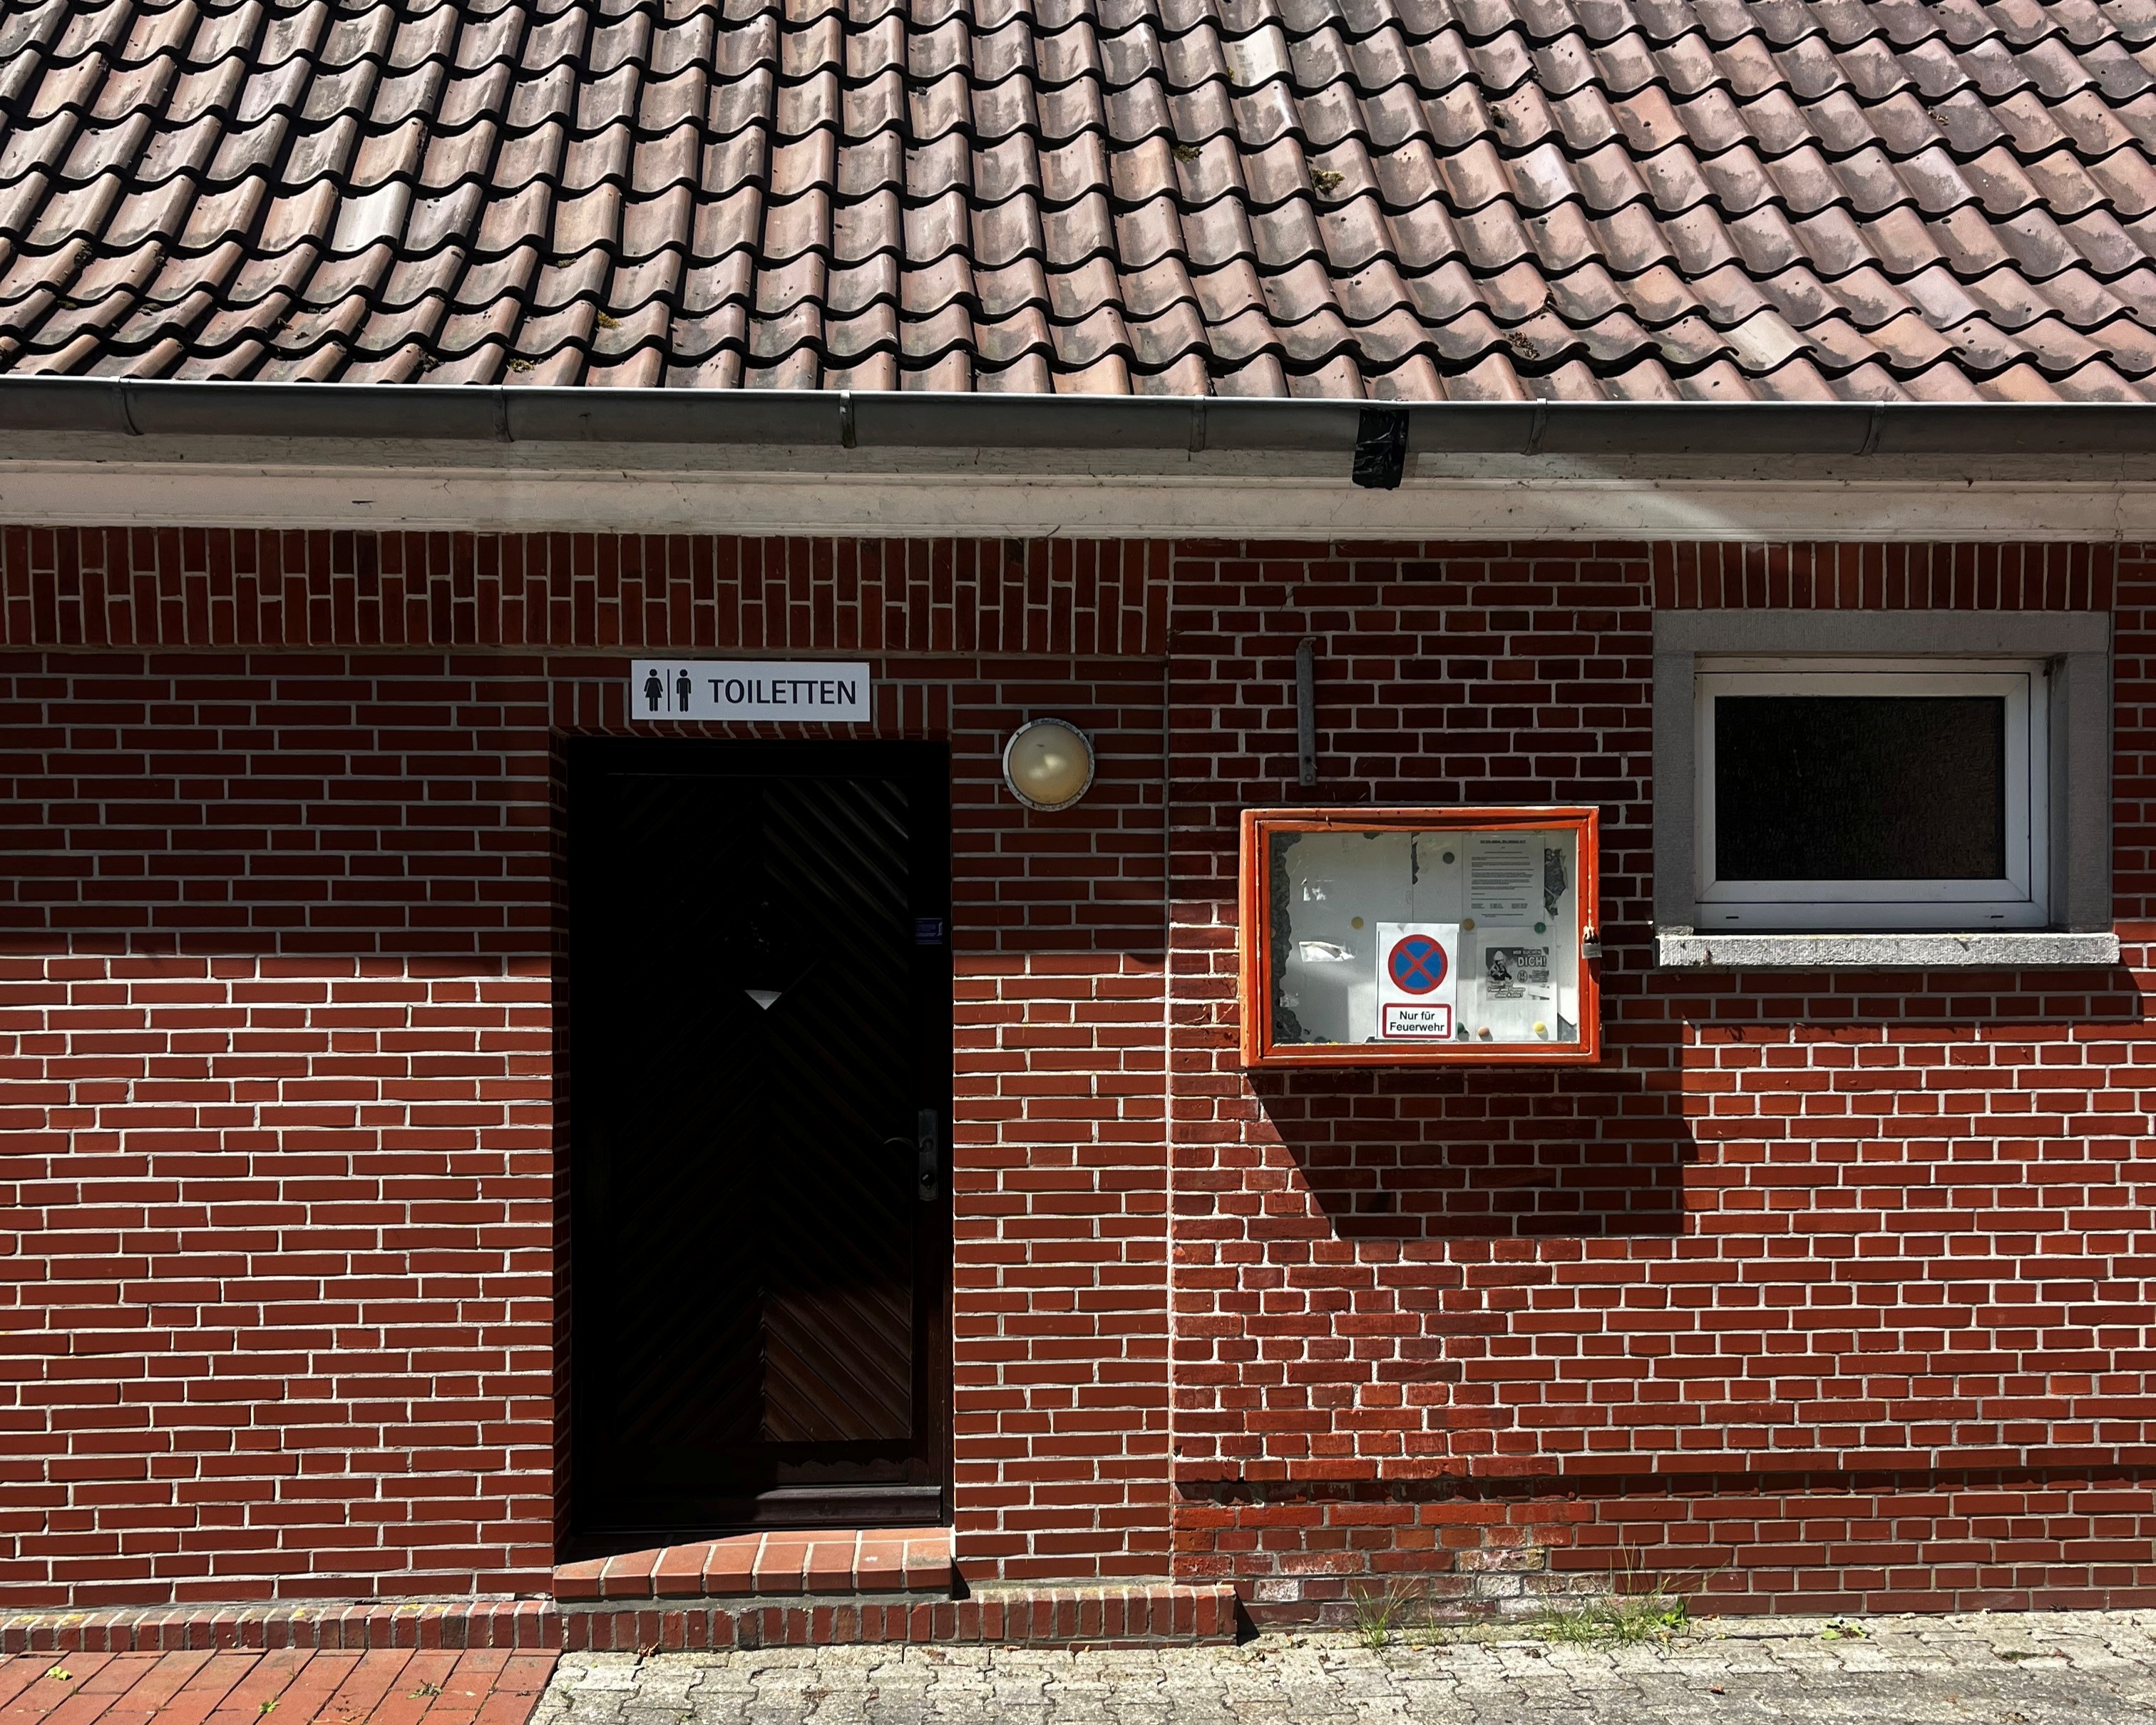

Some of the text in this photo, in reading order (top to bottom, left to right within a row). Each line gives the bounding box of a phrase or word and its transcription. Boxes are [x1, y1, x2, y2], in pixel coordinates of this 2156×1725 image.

[707, 679, 856, 705] TOILETTEN
[1517, 956, 1546, 966] DICH!
[1400, 1010, 1435, 1020] Nur für
[1390, 1022, 1444, 1031] Feuerwehr
